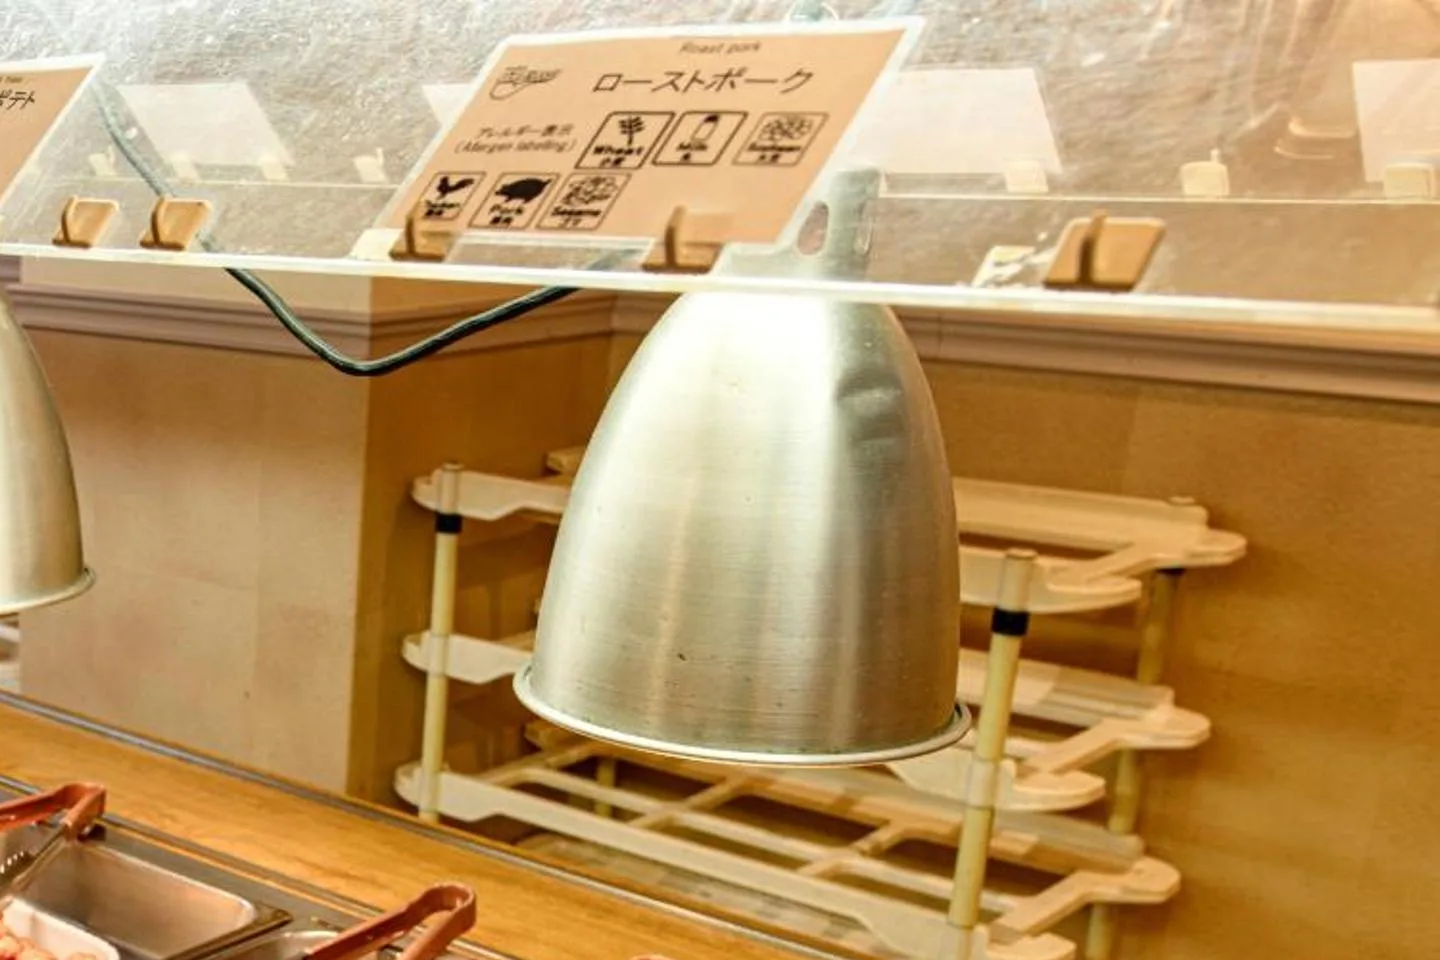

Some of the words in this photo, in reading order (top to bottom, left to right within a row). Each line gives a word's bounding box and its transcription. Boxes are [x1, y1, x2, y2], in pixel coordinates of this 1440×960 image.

[592, 66, 814, 94] ローストポーク
[593, 145, 643, 155] Wheat
